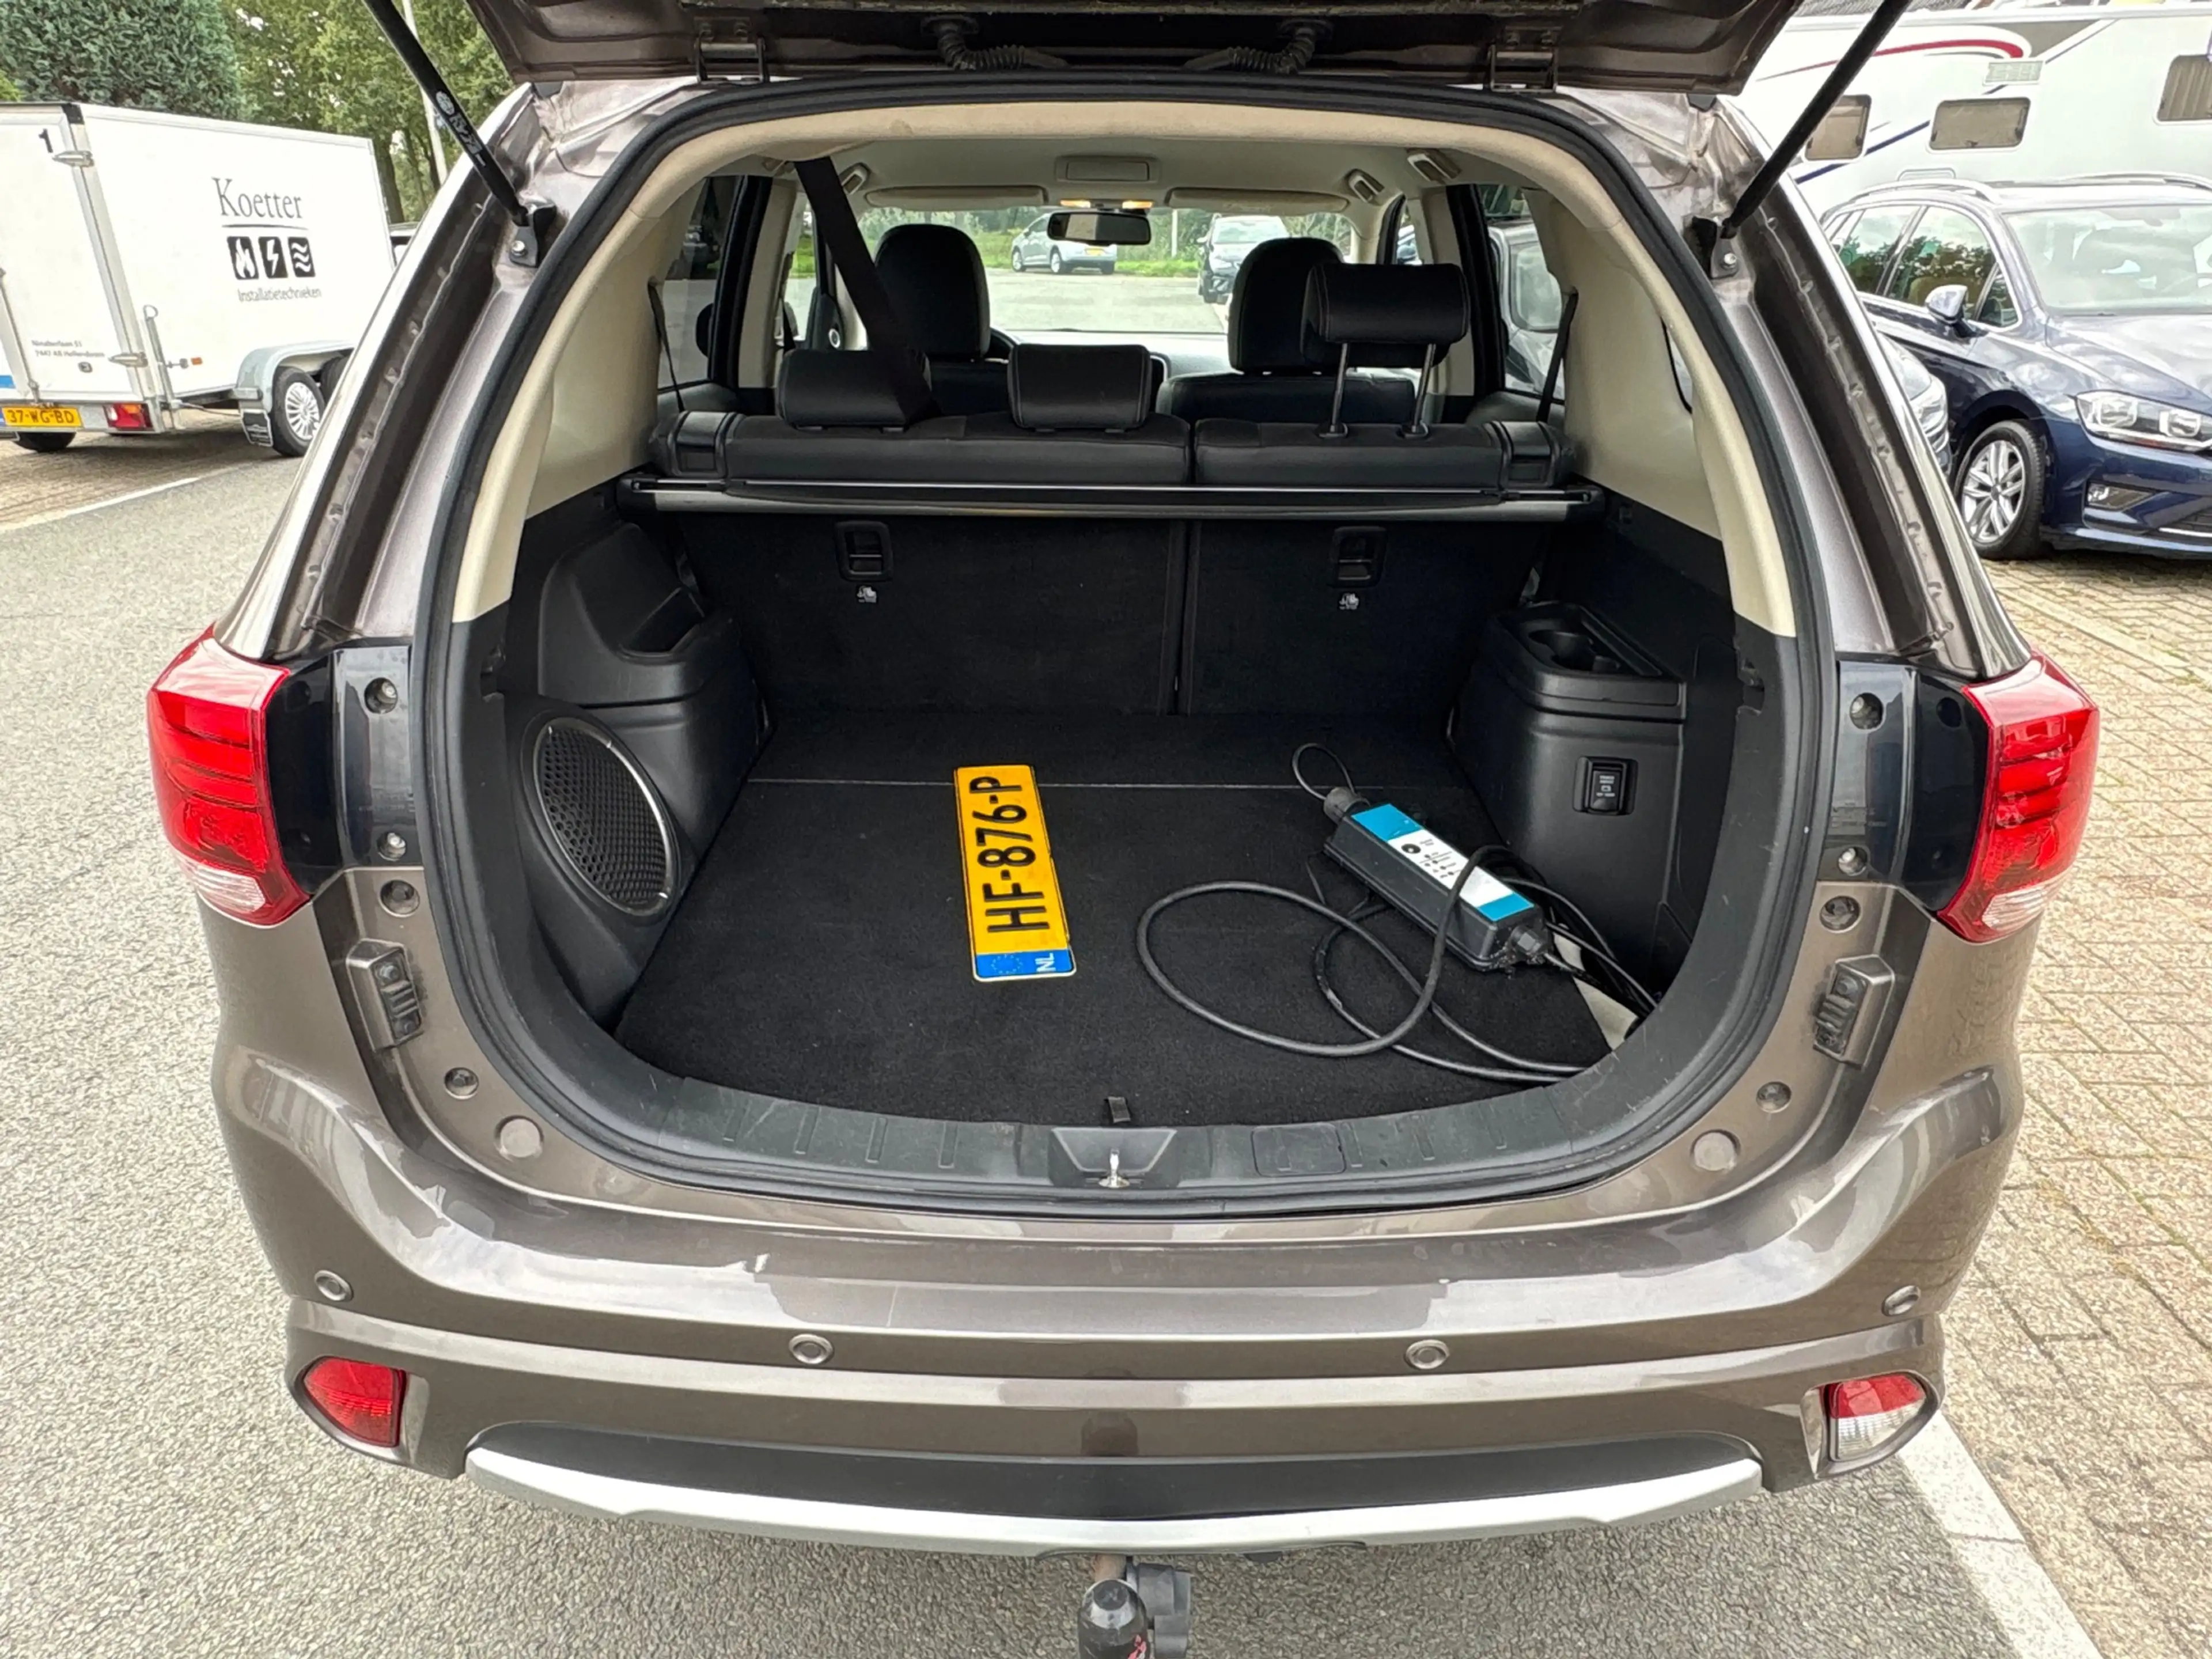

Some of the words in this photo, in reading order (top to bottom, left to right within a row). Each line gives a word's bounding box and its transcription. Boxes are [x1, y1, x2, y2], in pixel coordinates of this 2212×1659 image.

[38, 128, 53, 153] 1
[211, 176, 302, 218] Koetter
[7, 410, 74, 423] 37-WG-BD
[969, 776, 1050, 933] HF-876-P
[1035, 953, 1055, 972] NL
